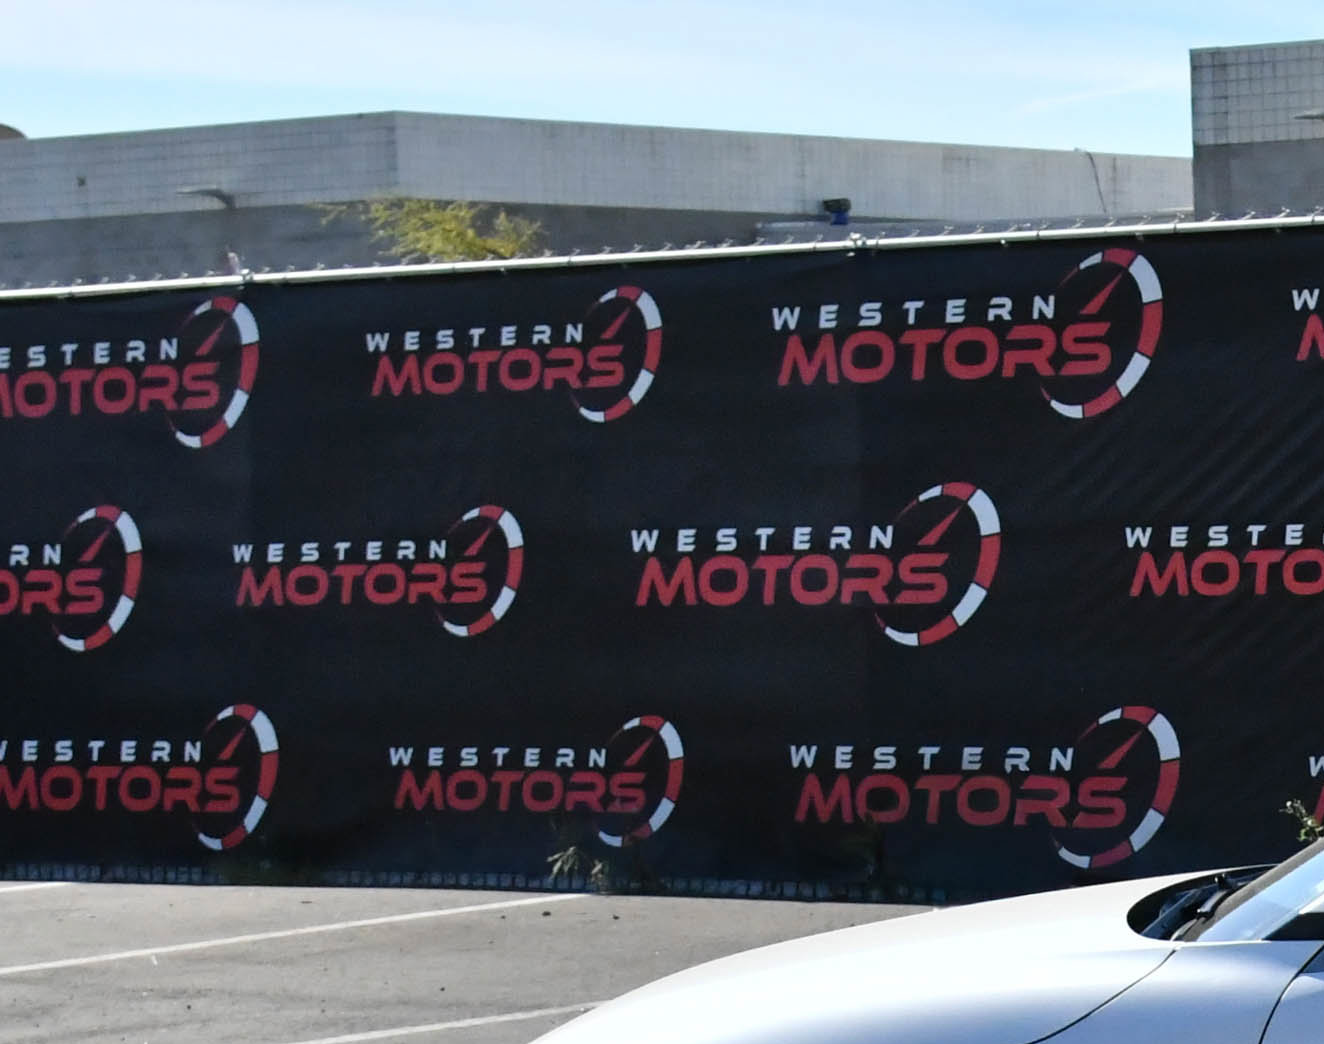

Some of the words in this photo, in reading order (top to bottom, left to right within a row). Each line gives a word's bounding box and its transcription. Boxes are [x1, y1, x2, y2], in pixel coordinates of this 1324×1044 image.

[772, 295, 1055, 331] WESTERN
[366, 323, 583, 353] WESTERN
[777, 321, 1111, 386] MOTORS
[371, 345, 624, 396] MOTORS
[233, 540, 446, 563] WESTERN
[631, 525, 894, 553] WESTERN
[236, 561, 487, 606] MOTORS
[635, 553, 949, 607] MOTORS
[389, 747, 606, 768] WESTERN
[790, 745, 1074, 773] WESTERN
[0, 765, 240, 812] MOTORS
[395, 771, 646, 812] MOTORS
[794, 774, 1127, 828] MOTORS
